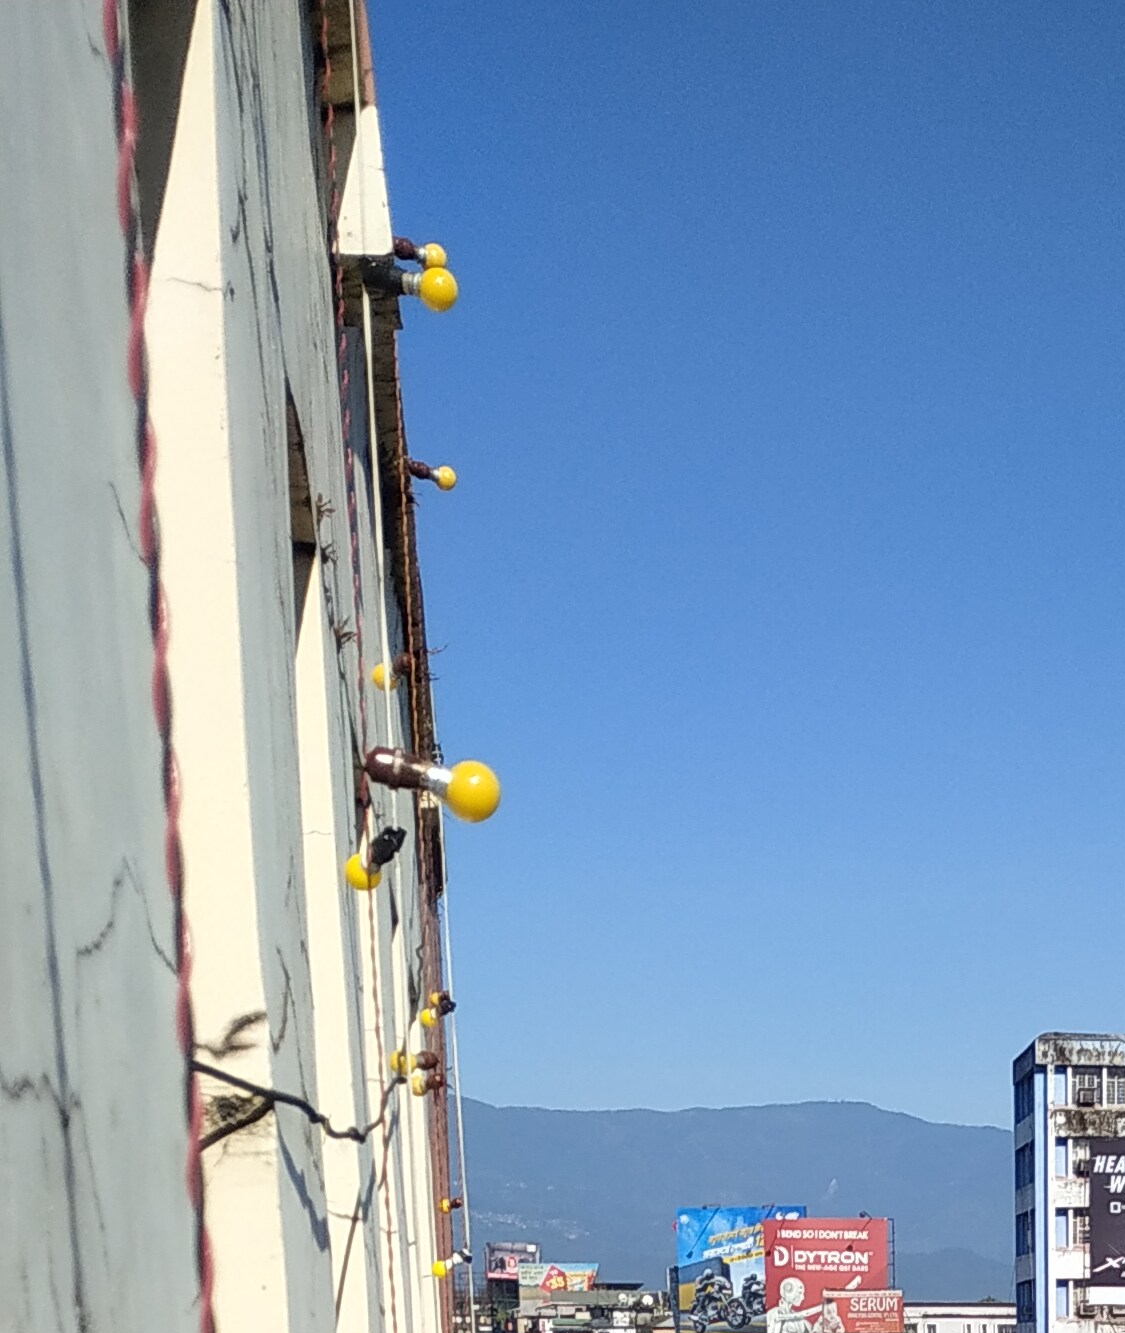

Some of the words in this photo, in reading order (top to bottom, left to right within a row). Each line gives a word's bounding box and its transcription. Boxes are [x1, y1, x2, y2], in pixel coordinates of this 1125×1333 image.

[781, 1229, 801, 1239] BEND
[803, 1229, 814, 1239] SO
[819, 1229, 843, 1240] DON'T
[844, 1230, 869, 1240] BREAK
[794, 1250, 868, 1264] DYTRON
[850, 1297, 898, 1312] SERUM
